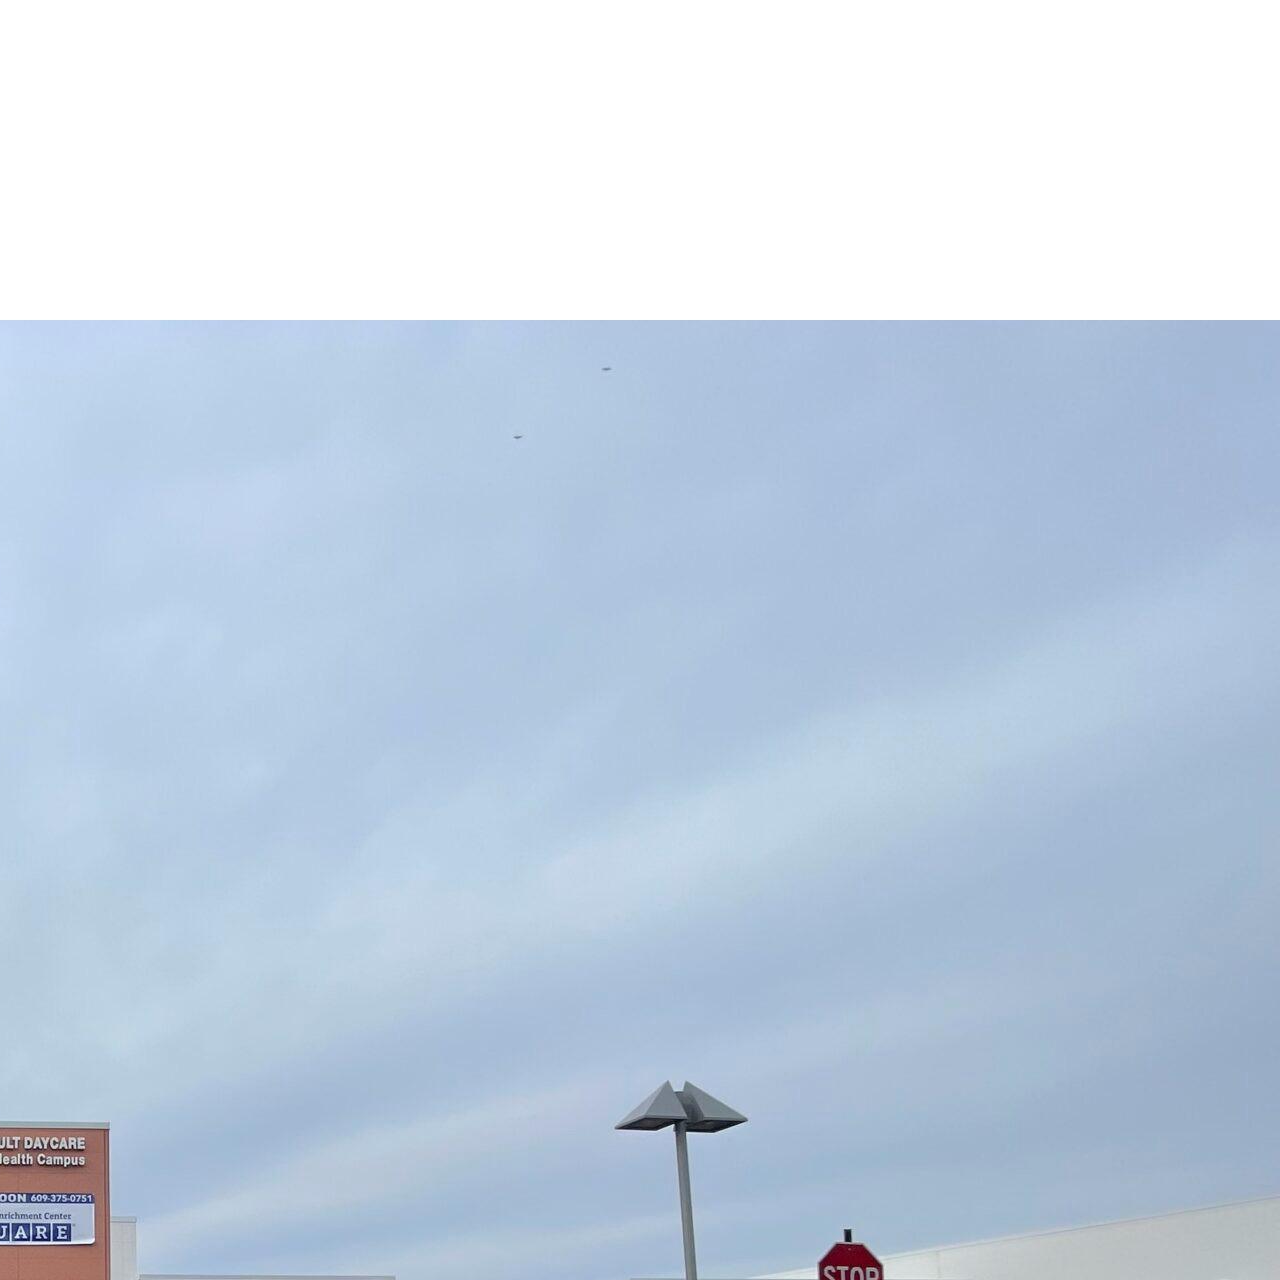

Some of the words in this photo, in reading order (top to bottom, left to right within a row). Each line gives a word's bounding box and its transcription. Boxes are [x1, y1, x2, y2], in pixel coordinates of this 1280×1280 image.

[24, 1137, 86, 1150] DAYCARE
[37, 1154, 86, 1167] Campus
[30, 1194, 93, 1203] 609-375-0751
[44, 1212, 72, 1221] Center
